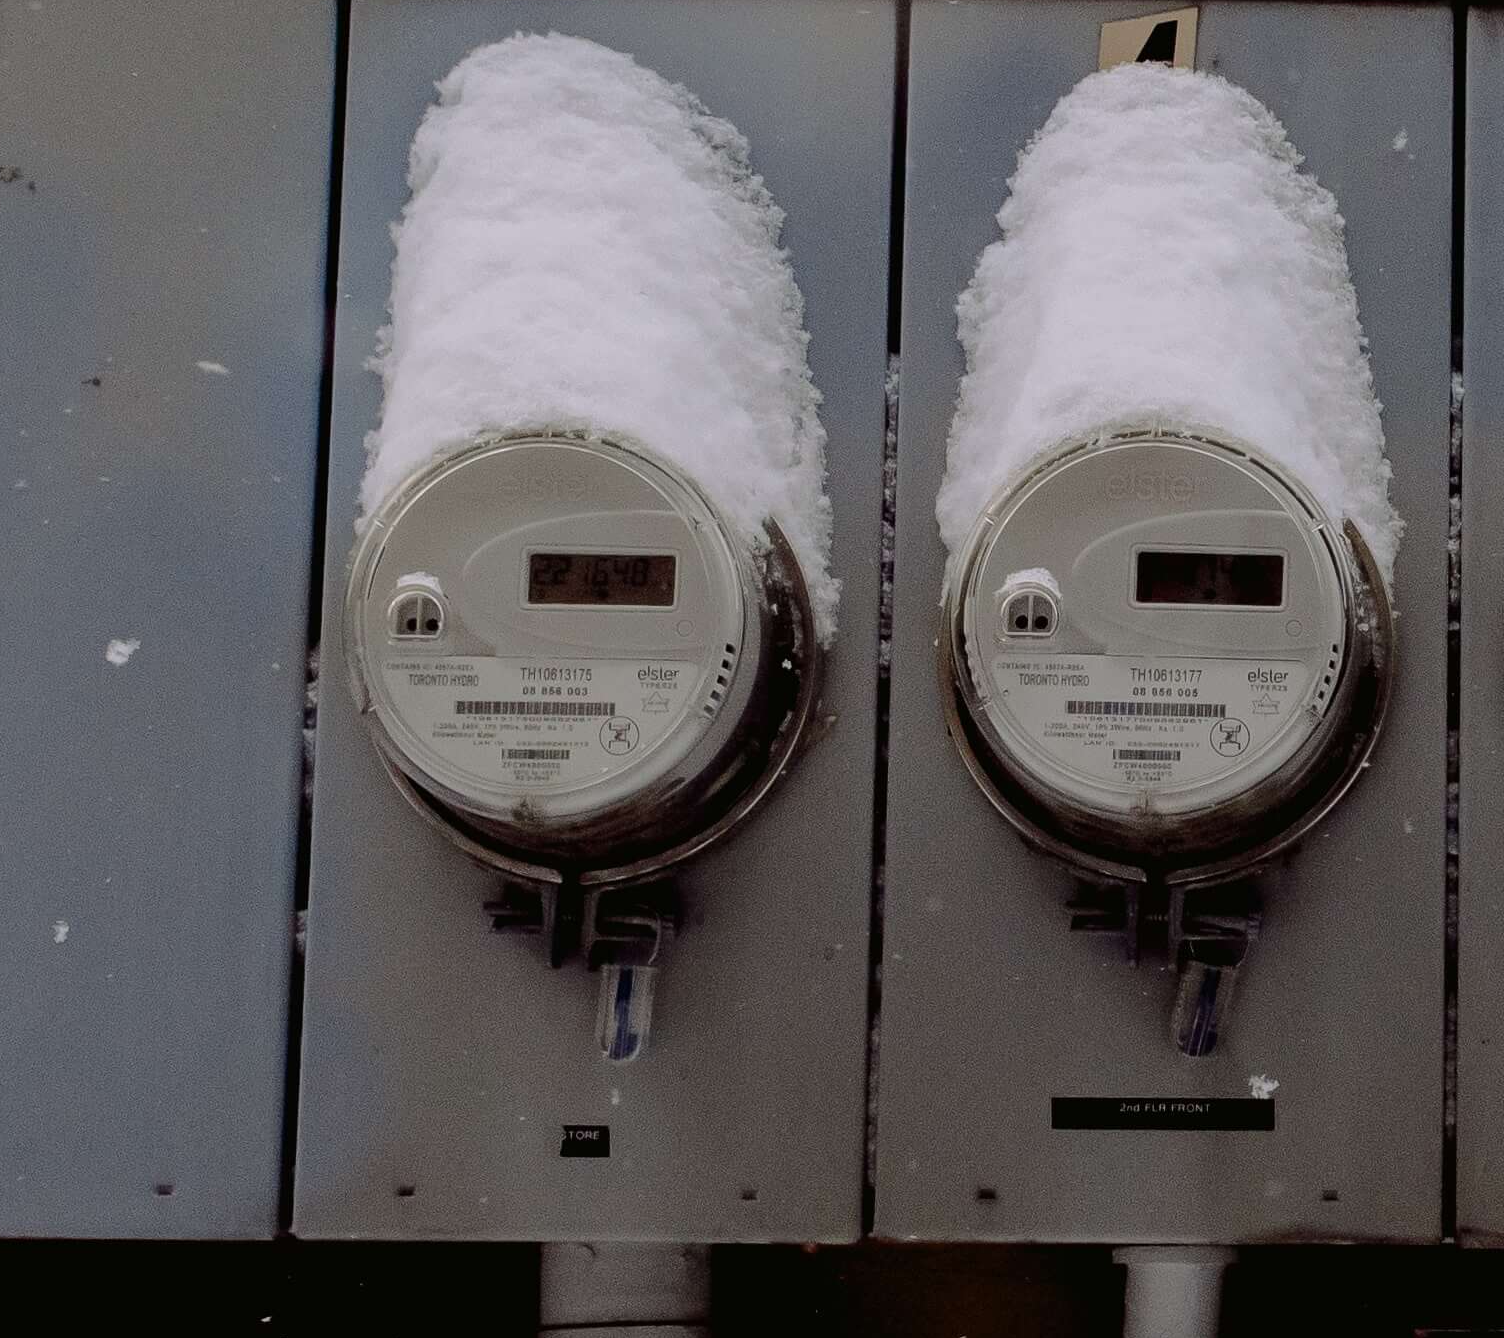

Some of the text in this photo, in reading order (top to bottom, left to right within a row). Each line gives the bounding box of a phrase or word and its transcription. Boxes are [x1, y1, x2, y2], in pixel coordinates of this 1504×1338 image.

[408, 673, 479, 687] TORONTO HYDRO
[637, 665, 680, 682] elster
[1018, 673, 1090, 688] TORONTO HYDRO
[1130, 667, 1203, 683] TH10613177
[1247, 667, 1289, 683] elster
[1132, 687, 1147, 697] 08
[1119, 1103, 1211, 1113] 2nd FLR FRONT
